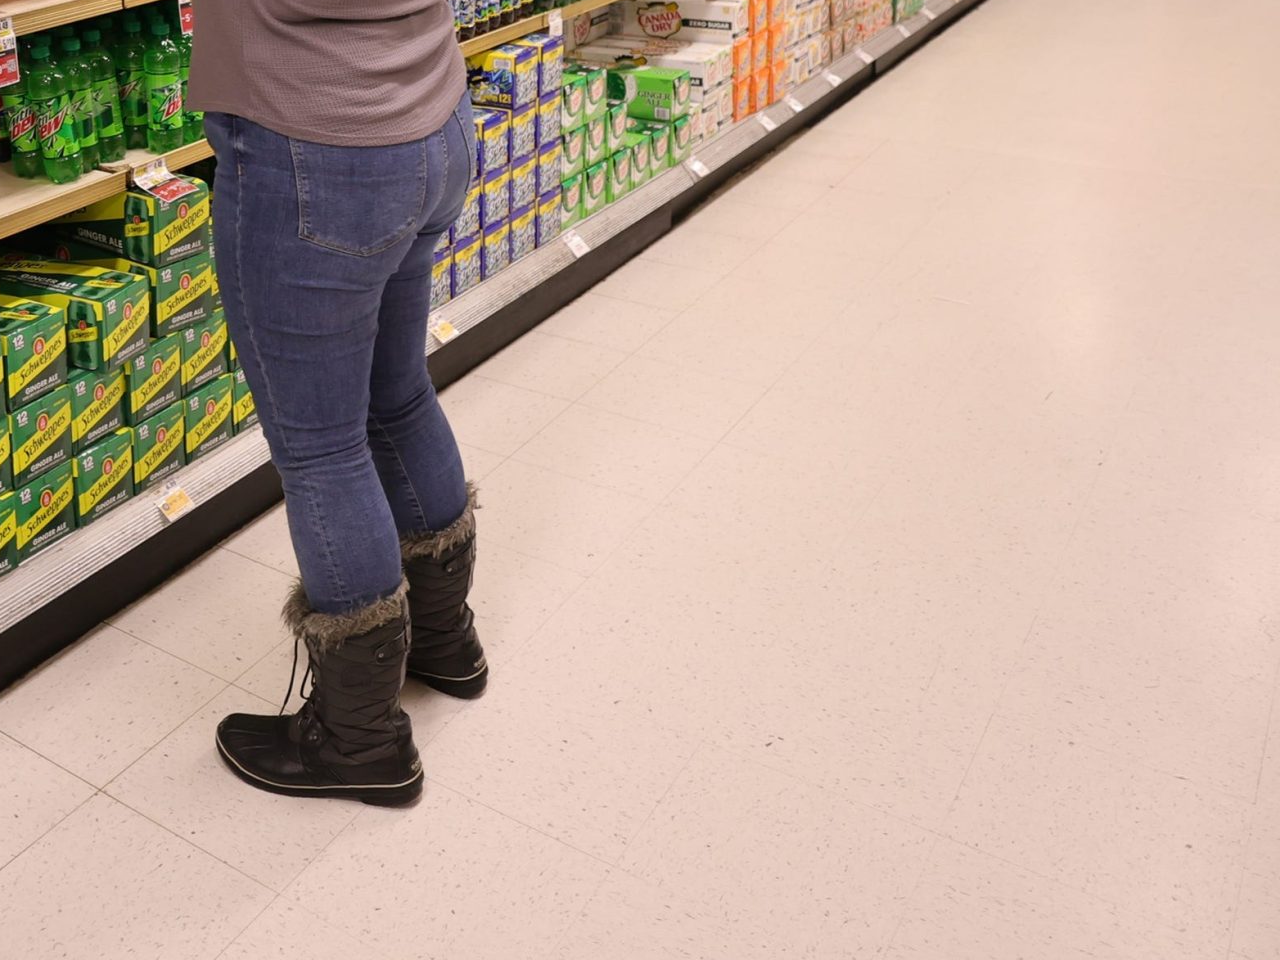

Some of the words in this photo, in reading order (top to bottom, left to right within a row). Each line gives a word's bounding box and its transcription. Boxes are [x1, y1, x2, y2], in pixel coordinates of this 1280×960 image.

[638, 11, 681, 28] CANADA
[651, 22, 673, 32] DRY
[166, 276, 208, 314] Schweppes
[13, 335, 25, 347] 12
[20, 336, 62, 386] Schweppes
[25, 377, 47, 395] GINGER
[47, 374, 58, 383] ALE
